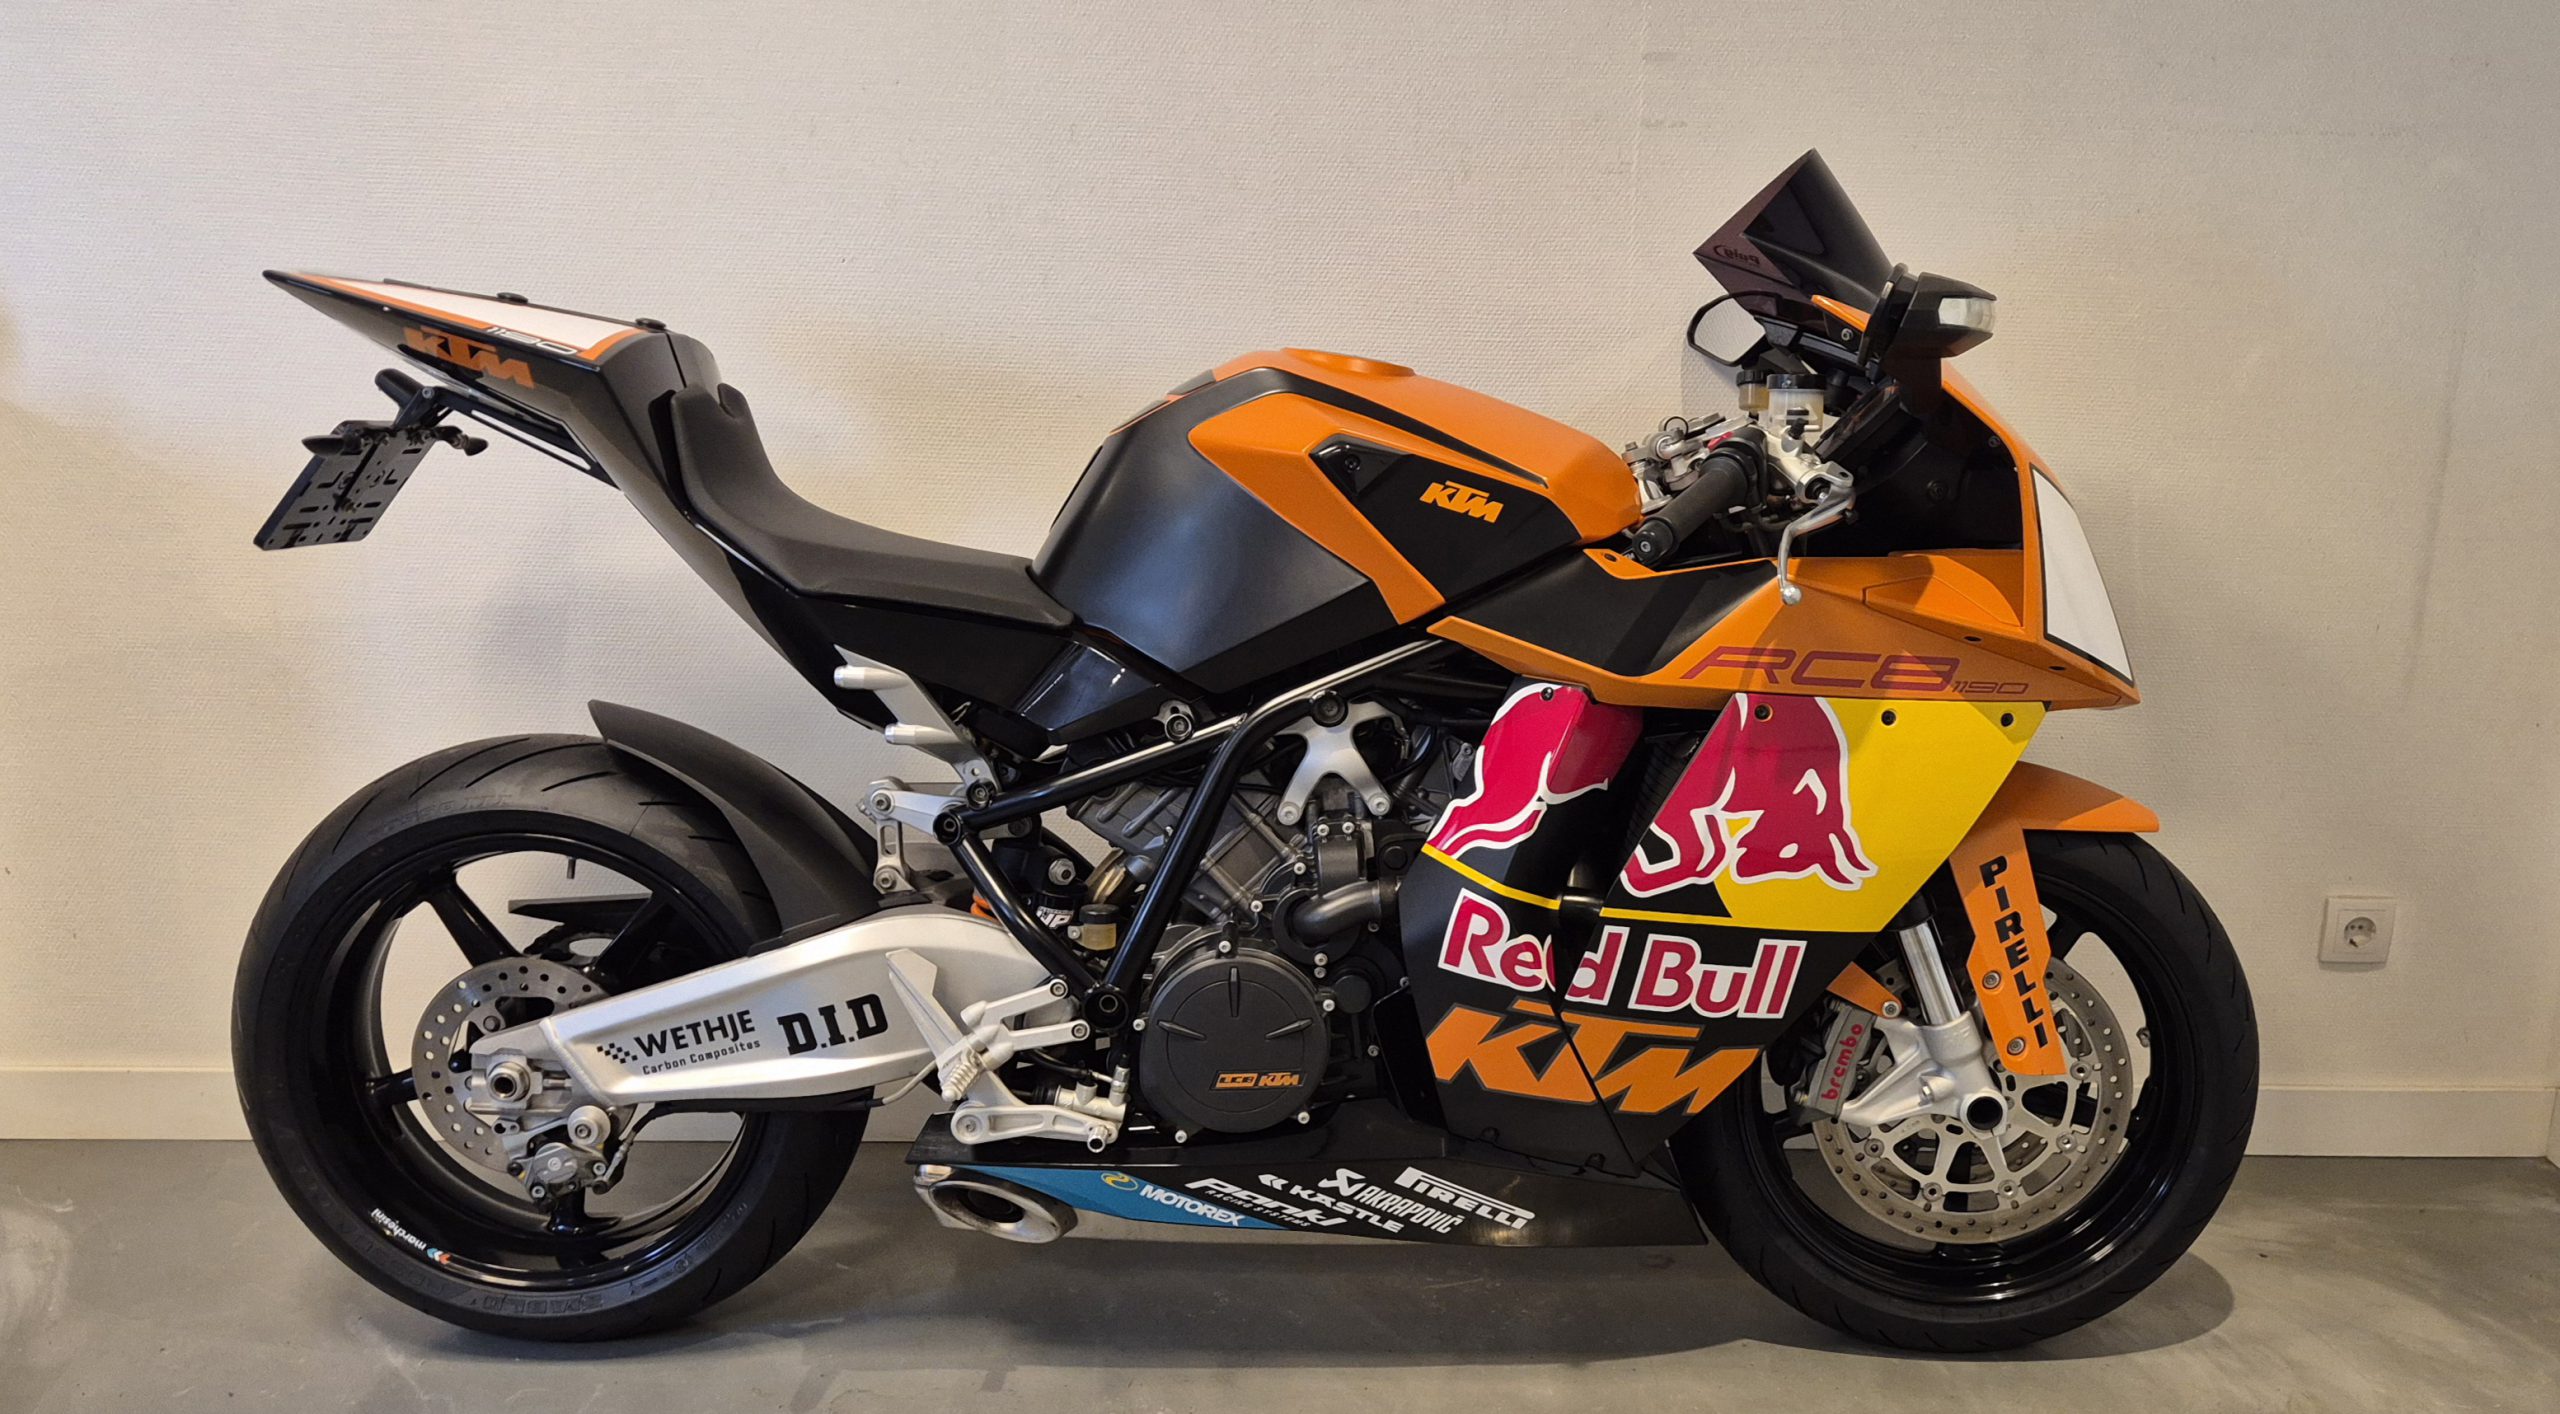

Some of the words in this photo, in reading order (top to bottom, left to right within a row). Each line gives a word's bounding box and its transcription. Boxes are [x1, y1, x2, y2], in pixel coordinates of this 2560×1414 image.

[401, 326, 534, 388] KTM
[1419, 480, 1504, 523] KTM
[1679, 645, 1960, 692] RC8
[1951, 680, 2029, 694] 1190
[1438, 888, 1630, 1005] Red
[1627, 933, 1807, 1018] Bull
[1979, 855, 2048, 1048] PIRELLI
[633, 1010, 756, 1057] WETHJE
[642, 1057, 687, 1075] Carbon
[690, 1040, 761, 1063] Composites
[1425, 996, 1765, 1115] KTM
[1258, 1072, 1300, 1087] KTM
[1821, 1023, 1864, 1100] brembo
[1139, 1184, 1246, 1227] MOTOREX
[1394, 1166, 1536, 1229] PIRELLI
